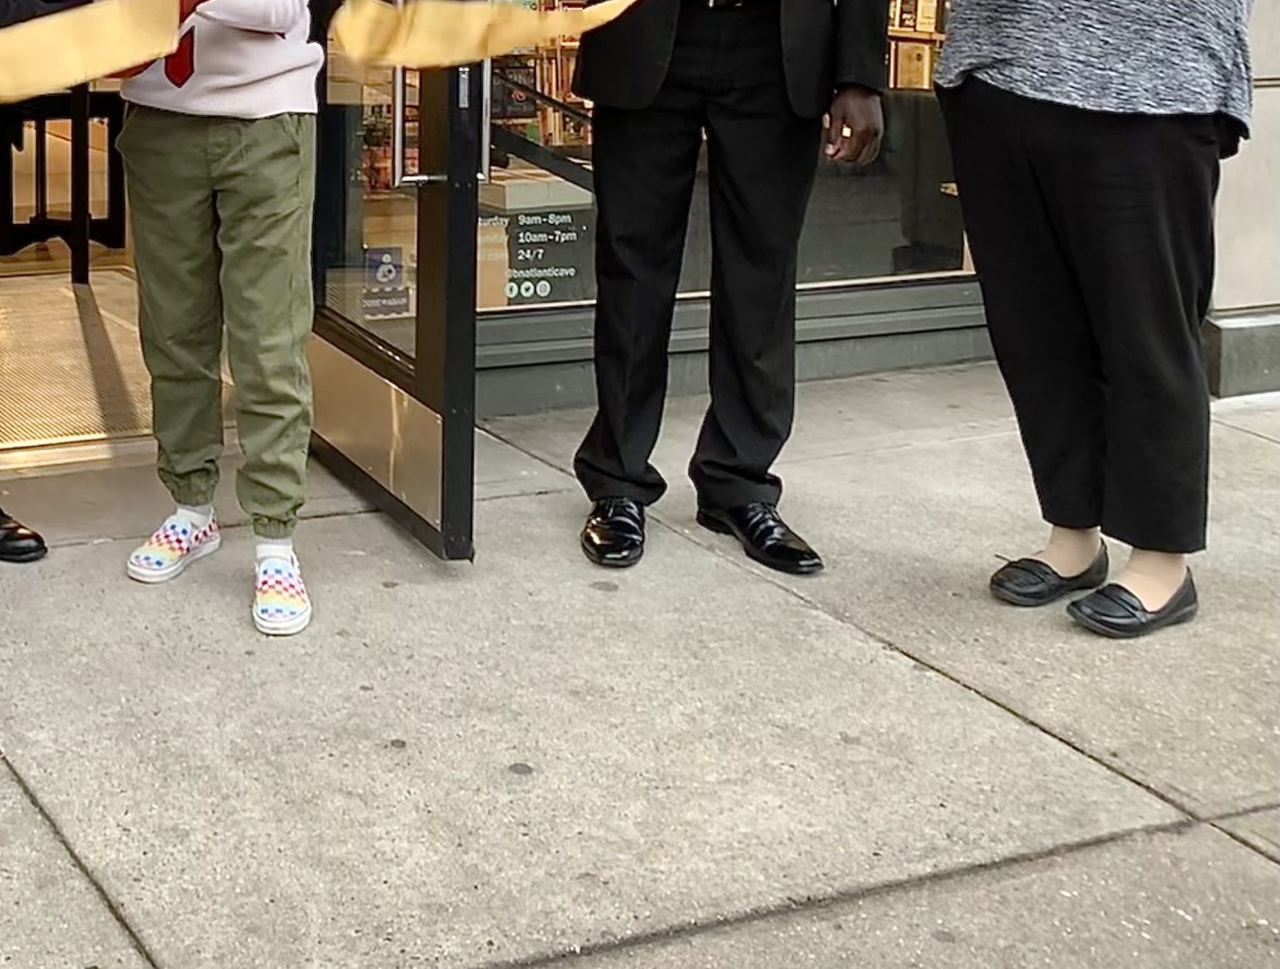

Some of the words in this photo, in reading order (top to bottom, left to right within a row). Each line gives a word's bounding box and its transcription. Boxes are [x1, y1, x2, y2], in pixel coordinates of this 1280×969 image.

[518, 214, 572, 225] 9am-8pm
[518, 231, 577, 242] 10am-7pm
[518, 249, 544, 260] 24/7
